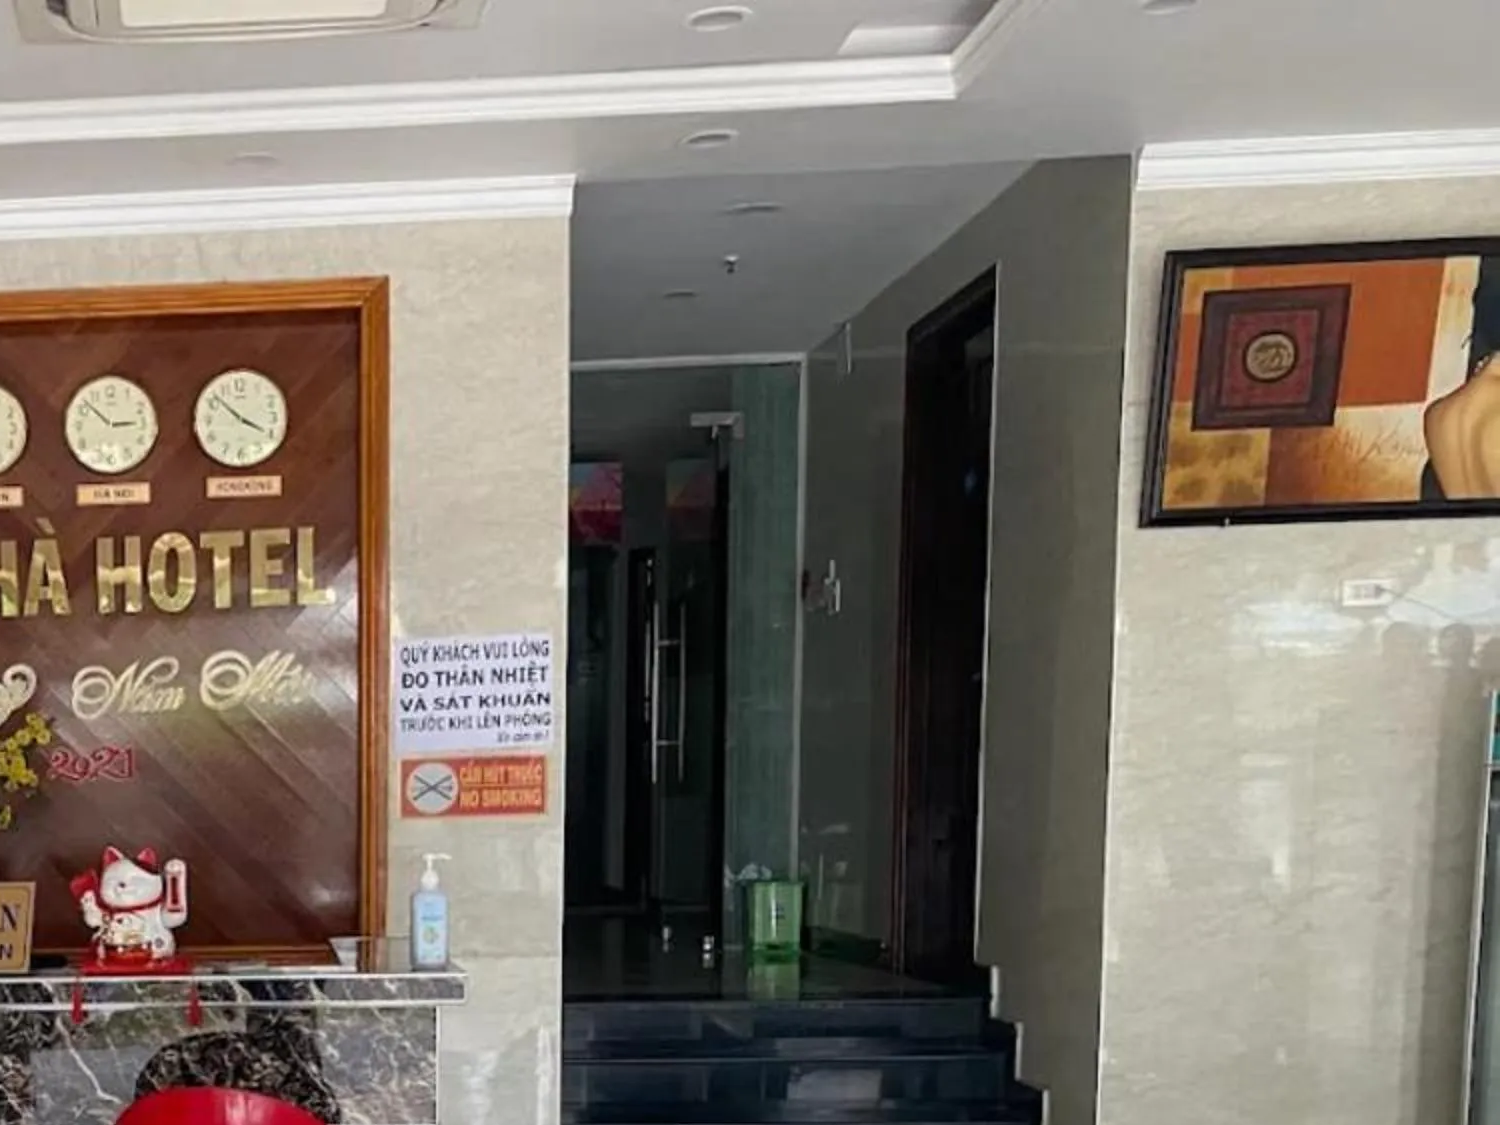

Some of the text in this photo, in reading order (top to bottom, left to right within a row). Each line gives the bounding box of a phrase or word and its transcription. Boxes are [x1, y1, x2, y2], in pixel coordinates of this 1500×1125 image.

[96, 526, 337, 614] HOTEL
[401, 635, 549, 667] QUÝ KHÁCH VUI LÒNG
[401, 661, 549, 689] ĐO THÂN NHIỆT
[400, 693, 427, 712] VÀ
[432, 691, 472, 710] SÁT
[448, 715, 473, 730] KHI
[477, 711, 501, 729] LÊN
[48, 744, 134, 781] 2021
